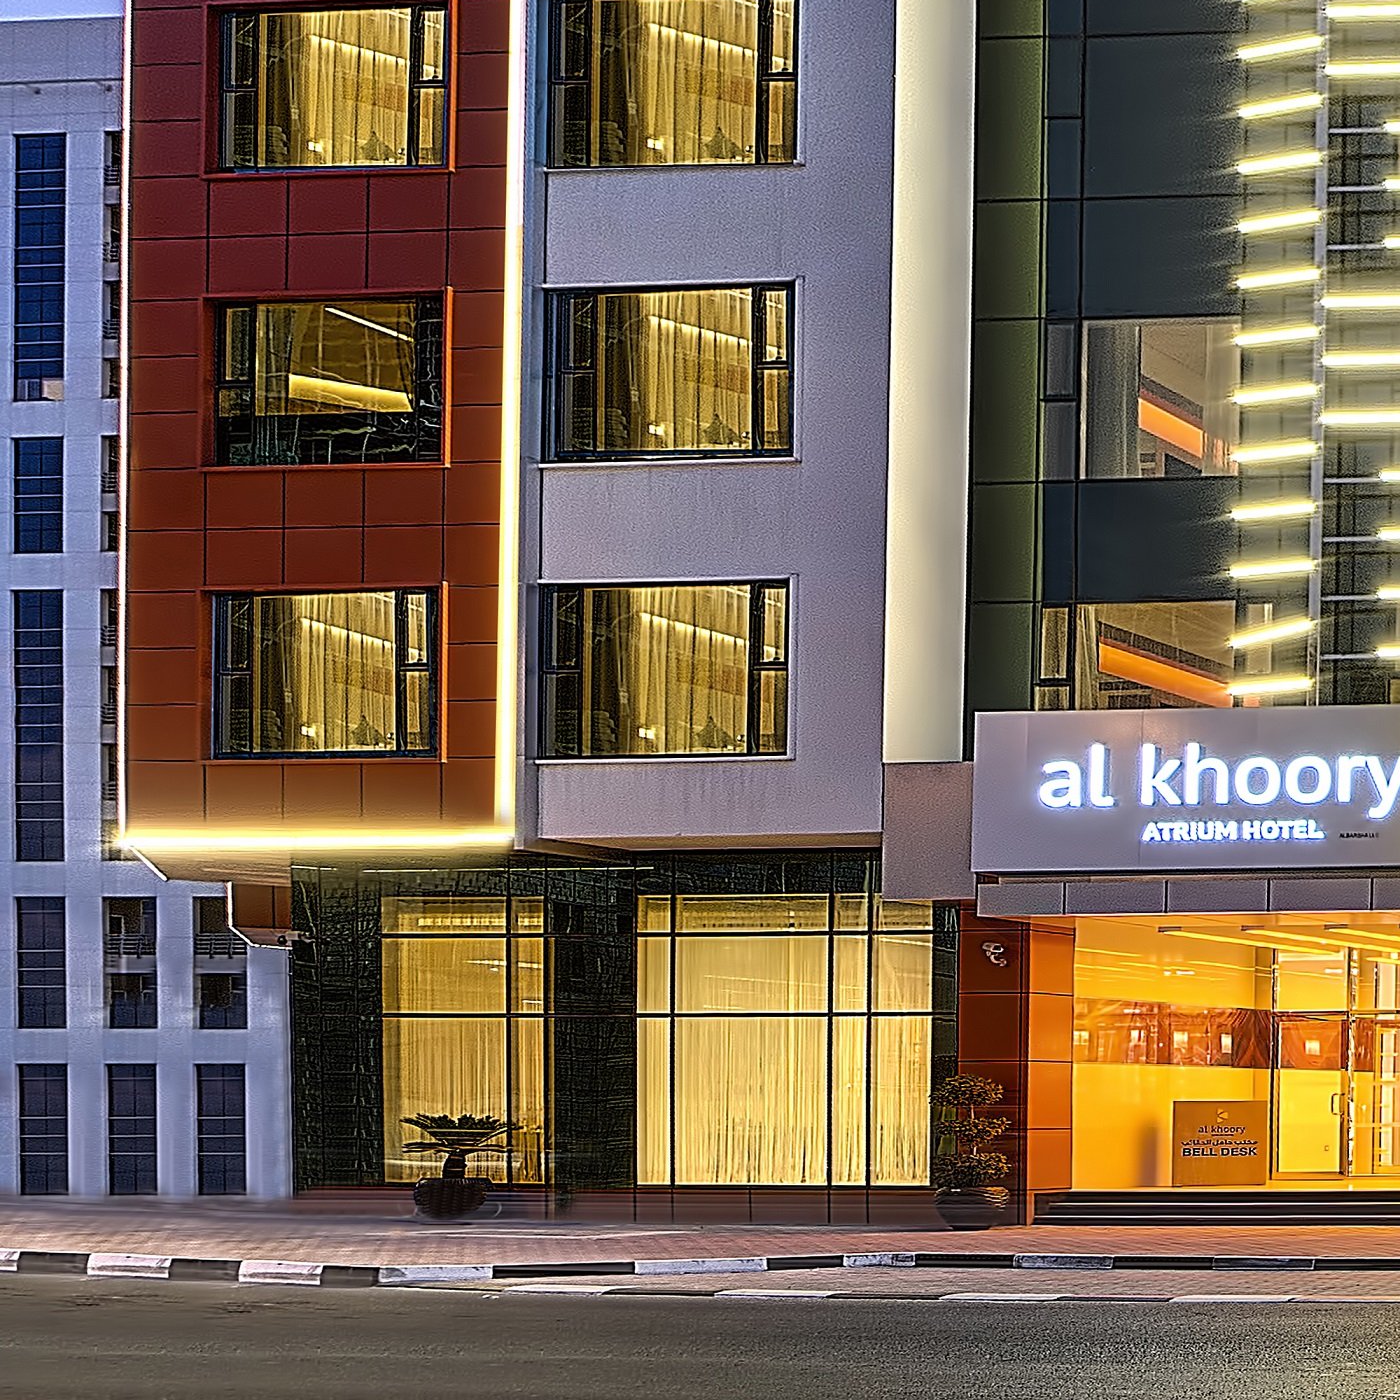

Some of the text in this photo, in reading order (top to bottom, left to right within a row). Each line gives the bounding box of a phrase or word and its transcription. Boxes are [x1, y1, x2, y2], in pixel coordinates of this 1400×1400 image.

[1038, 742, 1115, 808] al
[1142, 819, 1326, 842] ATRIUM HOTEL
[1198, 1125, 1208, 1133] al
[1210, 1125, 1246, 1135] khoory
[1182, 1146, 1258, 1157] BELL DESK
